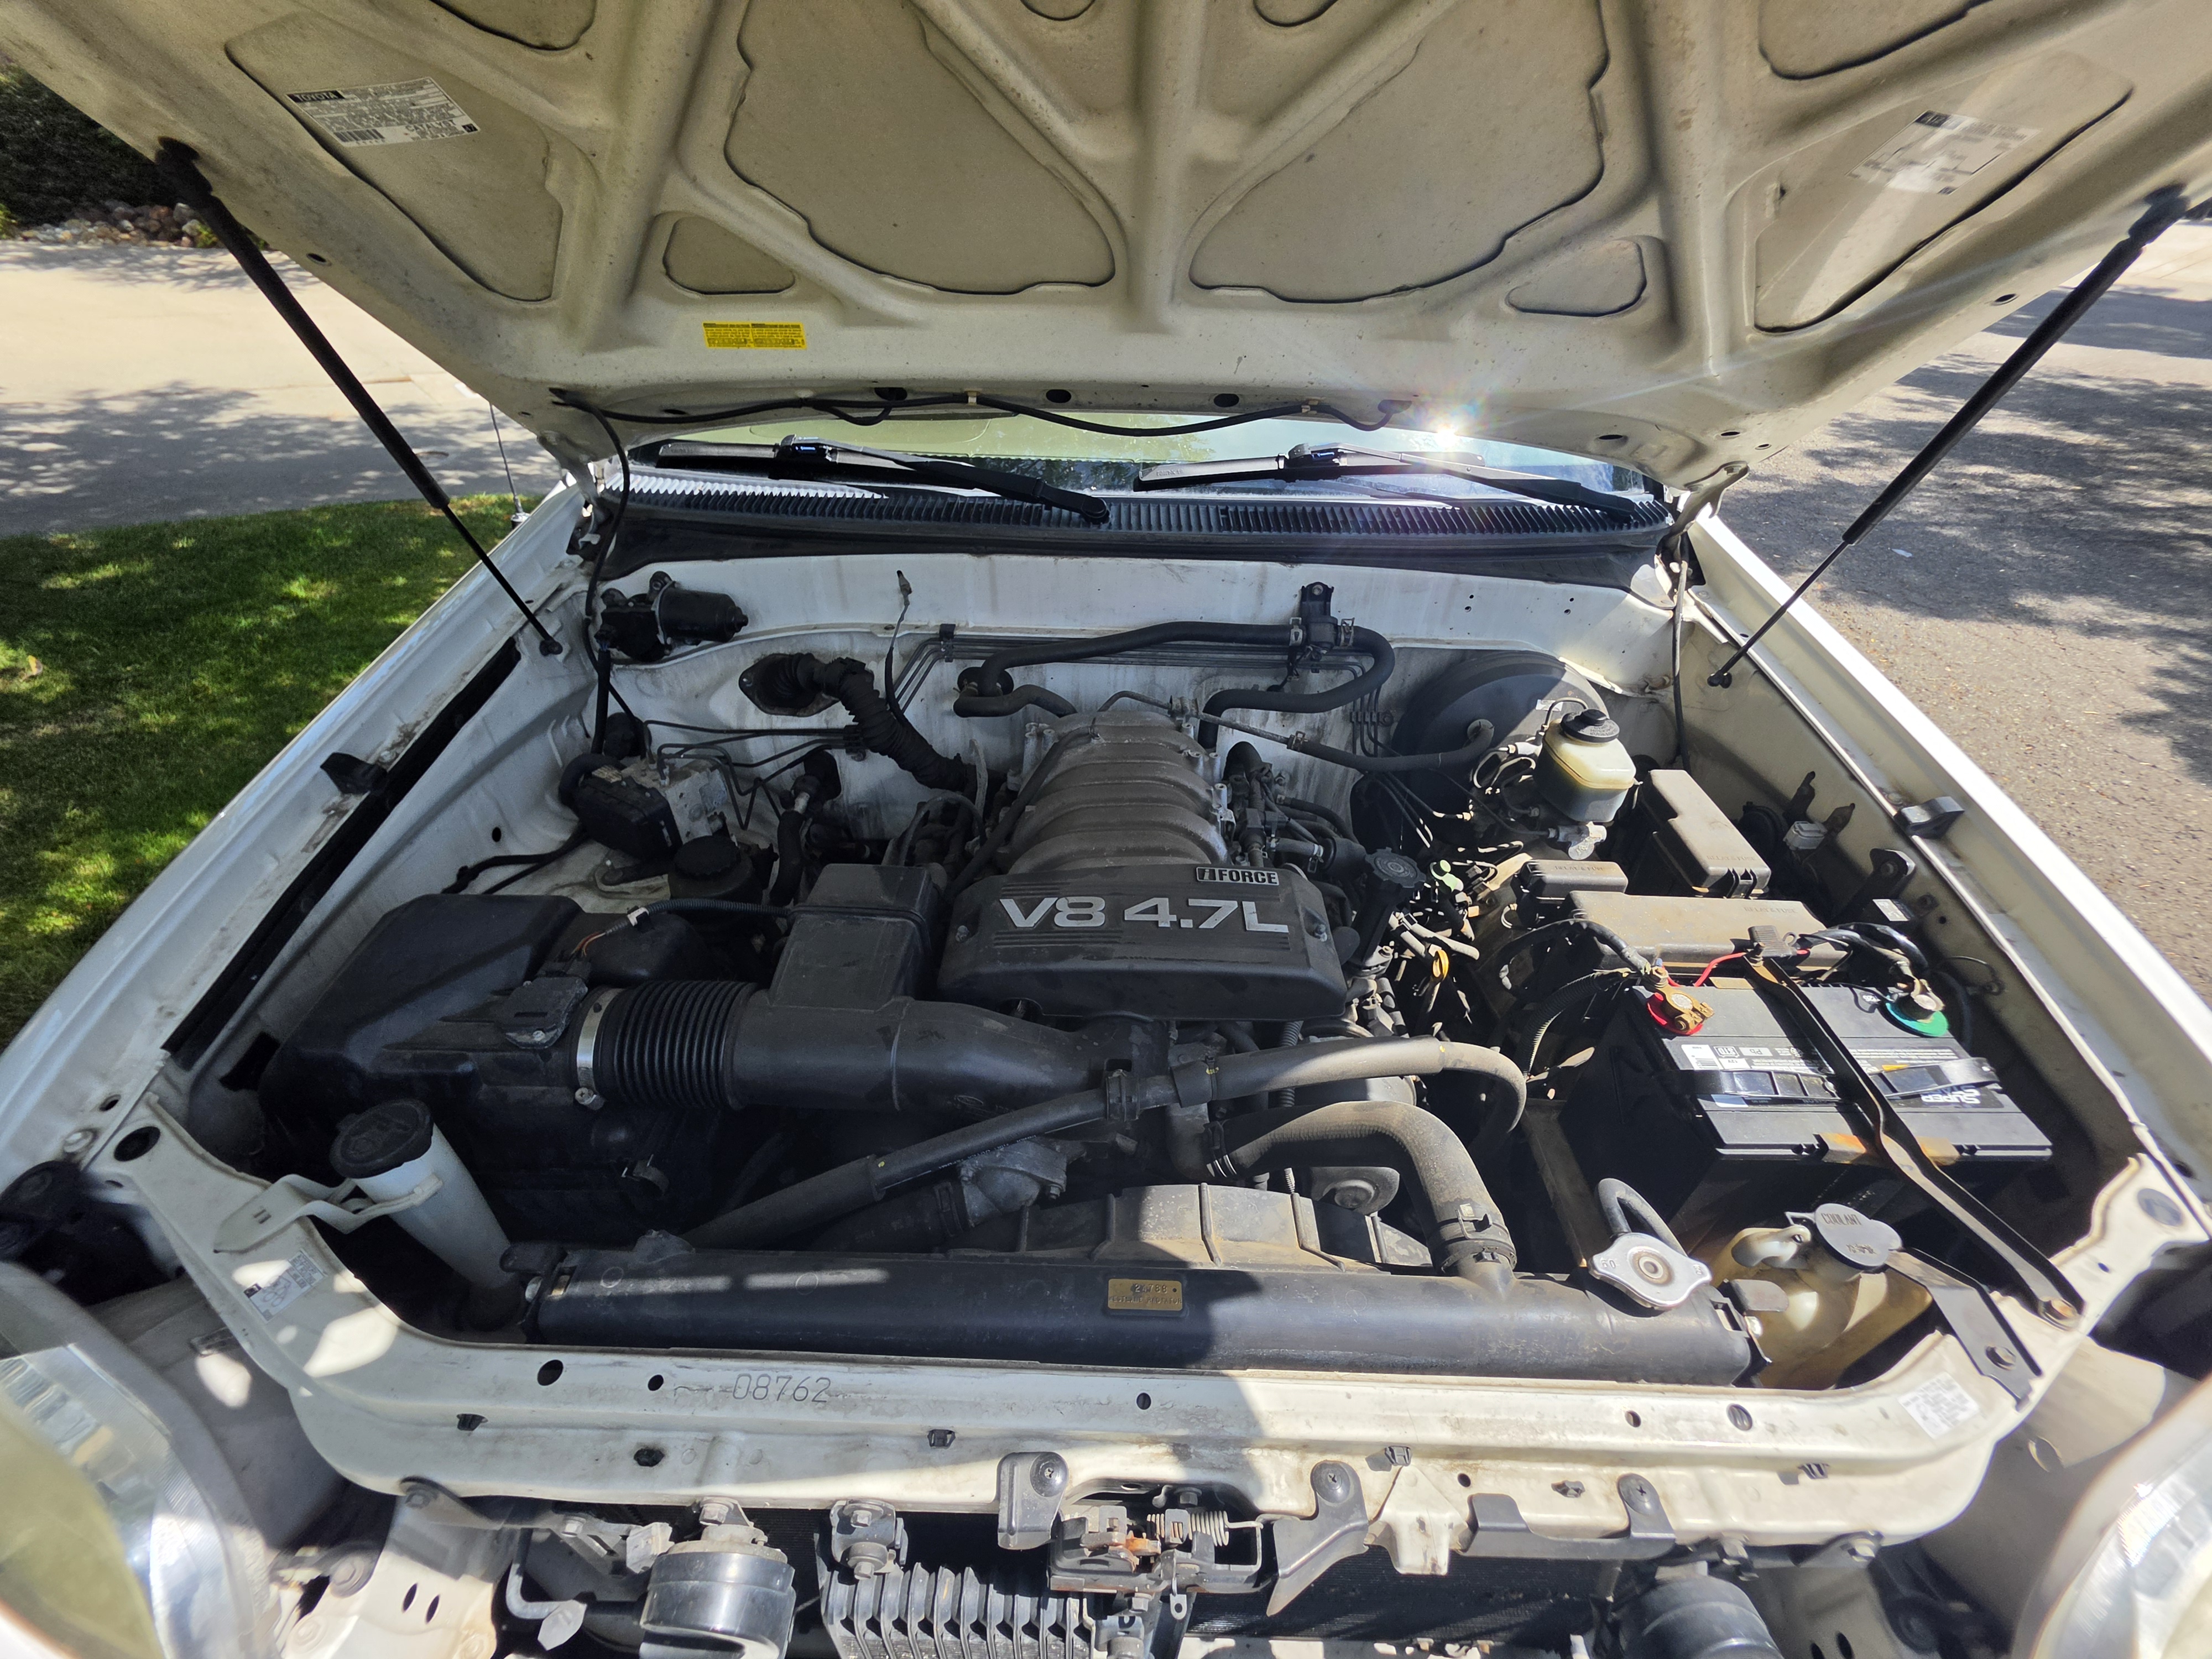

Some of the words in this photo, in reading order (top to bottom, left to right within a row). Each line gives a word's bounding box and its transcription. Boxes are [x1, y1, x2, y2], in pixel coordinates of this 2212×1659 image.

[295, 91, 336, 102] TOYOTA
[405, 118, 456, 133] CATALYST
[999, 896, 1105, 928] V8
[1124, 897, 1289, 933] 4.7L
[1921, 1093, 1981, 1104] SUPER
[1820, 1213, 1863, 1226] COOLANT
[732, 1373, 832, 1404] 08762
